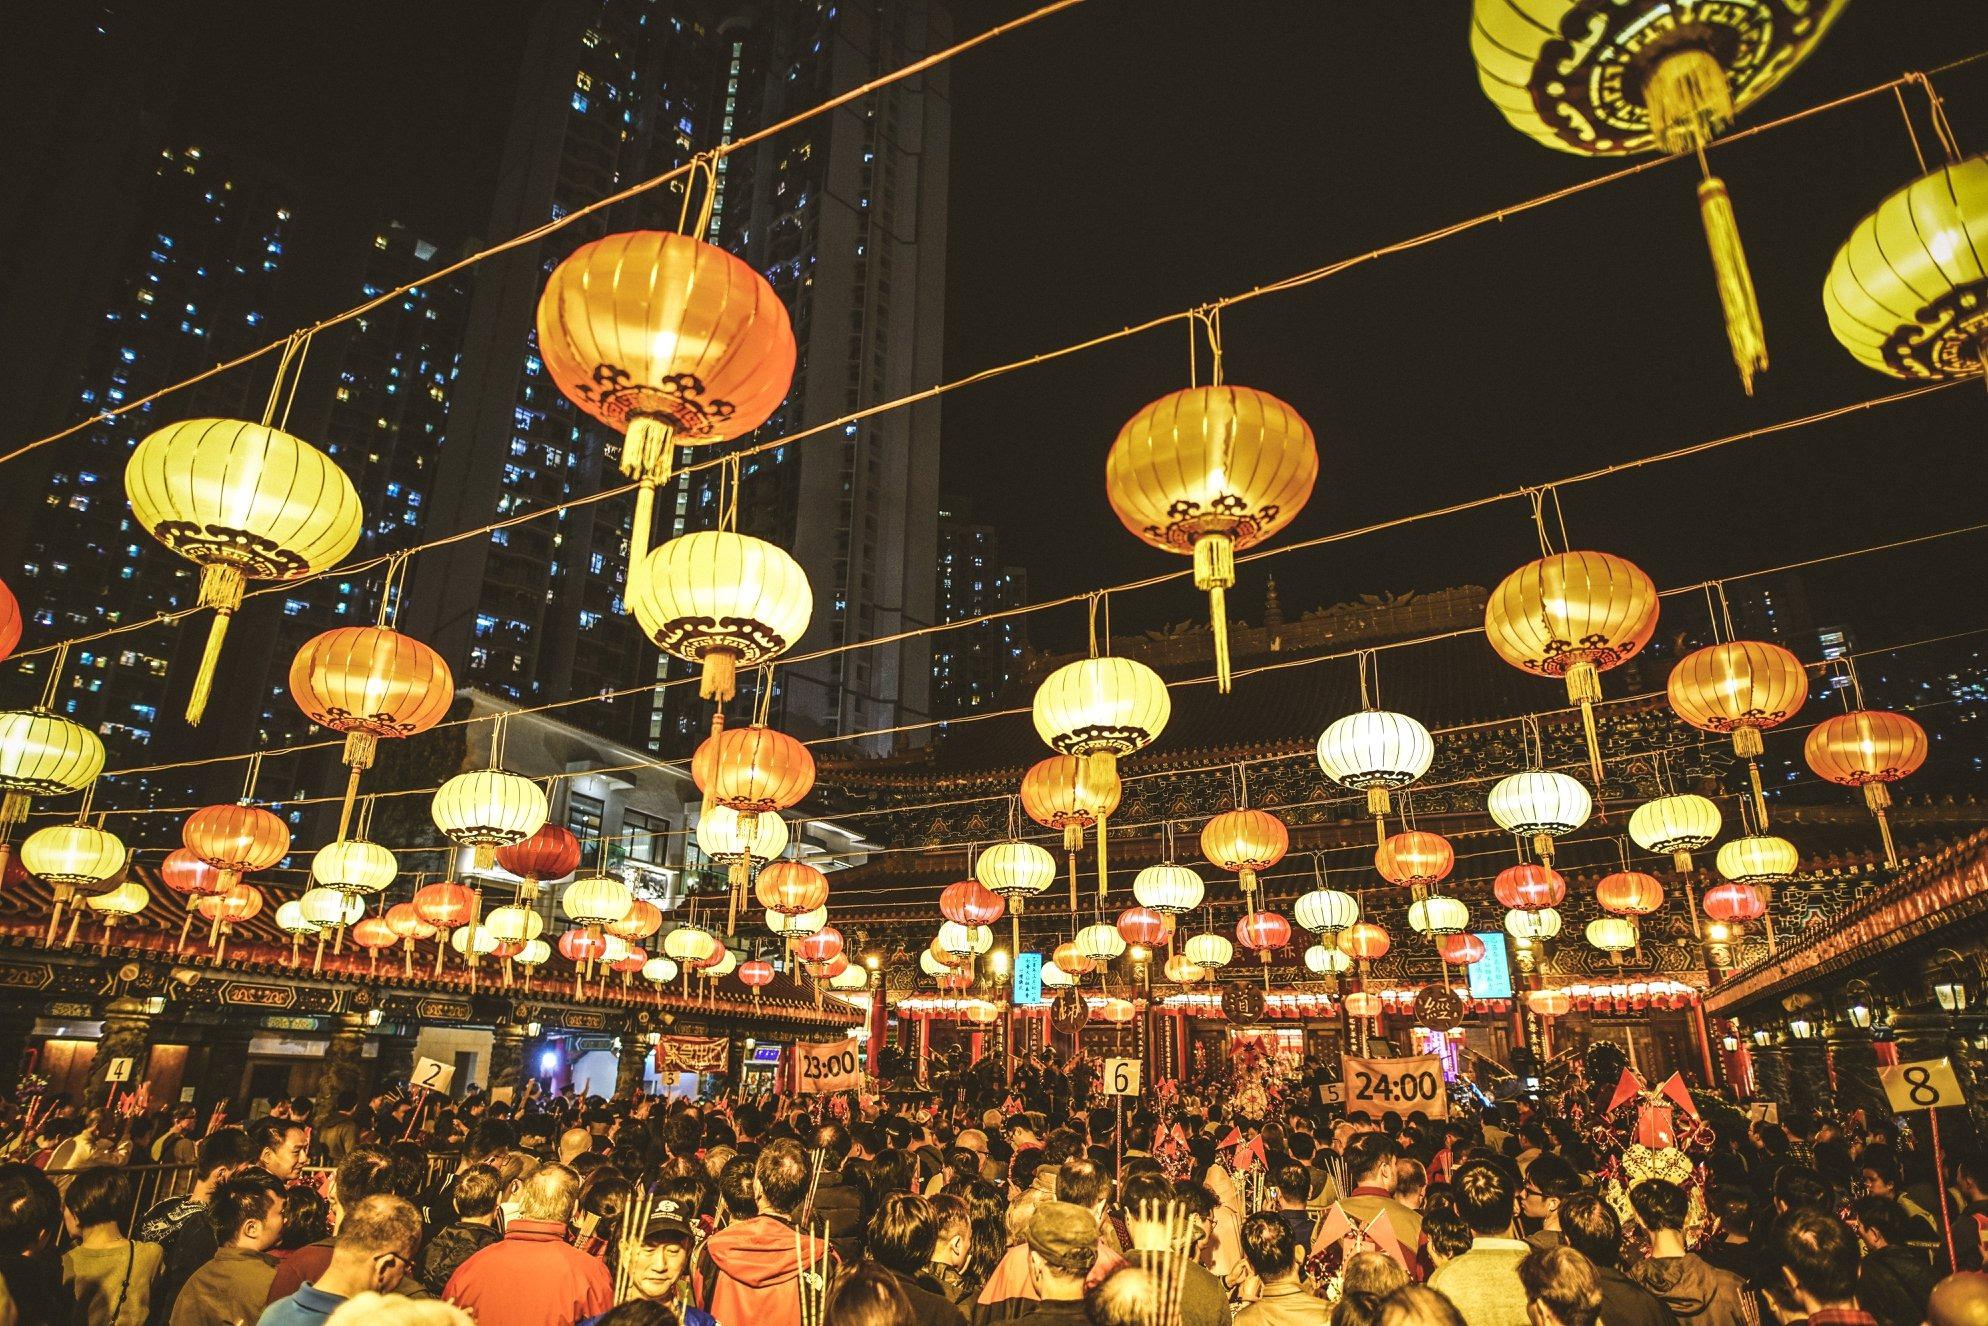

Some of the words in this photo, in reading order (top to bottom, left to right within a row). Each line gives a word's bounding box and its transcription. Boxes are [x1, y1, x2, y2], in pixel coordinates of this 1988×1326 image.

[1230, 989, 1255, 1018] 道
[1424, 996, 1452, 1020] 經
[113, 1060, 124, 1079] 4
[422, 1062, 442, 1087] 2
[803, 1050, 855, 1080] 23:00
[1114, 1062, 1129, 1093] 6
[1328, 1085, 1339, 1102] 5
[1355, 1071, 1438, 1102] 24:00
[1903, 1066, 1940, 1106] 8
[1758, 1104, 1769, 1121] 7
